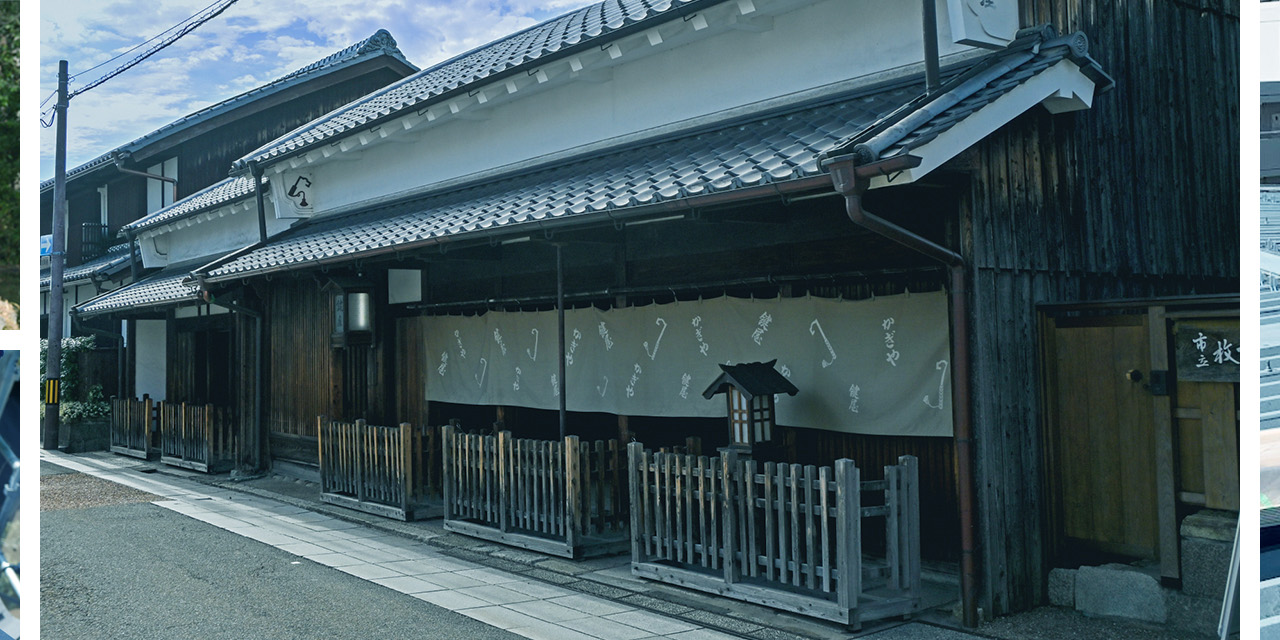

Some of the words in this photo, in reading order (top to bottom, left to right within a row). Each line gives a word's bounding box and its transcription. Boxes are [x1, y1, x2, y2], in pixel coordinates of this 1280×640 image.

[692, 315, 709, 356] かぎや
[882, 317, 900, 367] かぎや
[1192, 332, 1210, 368] 市立
[1213, 338, 1240, 365] 枚
